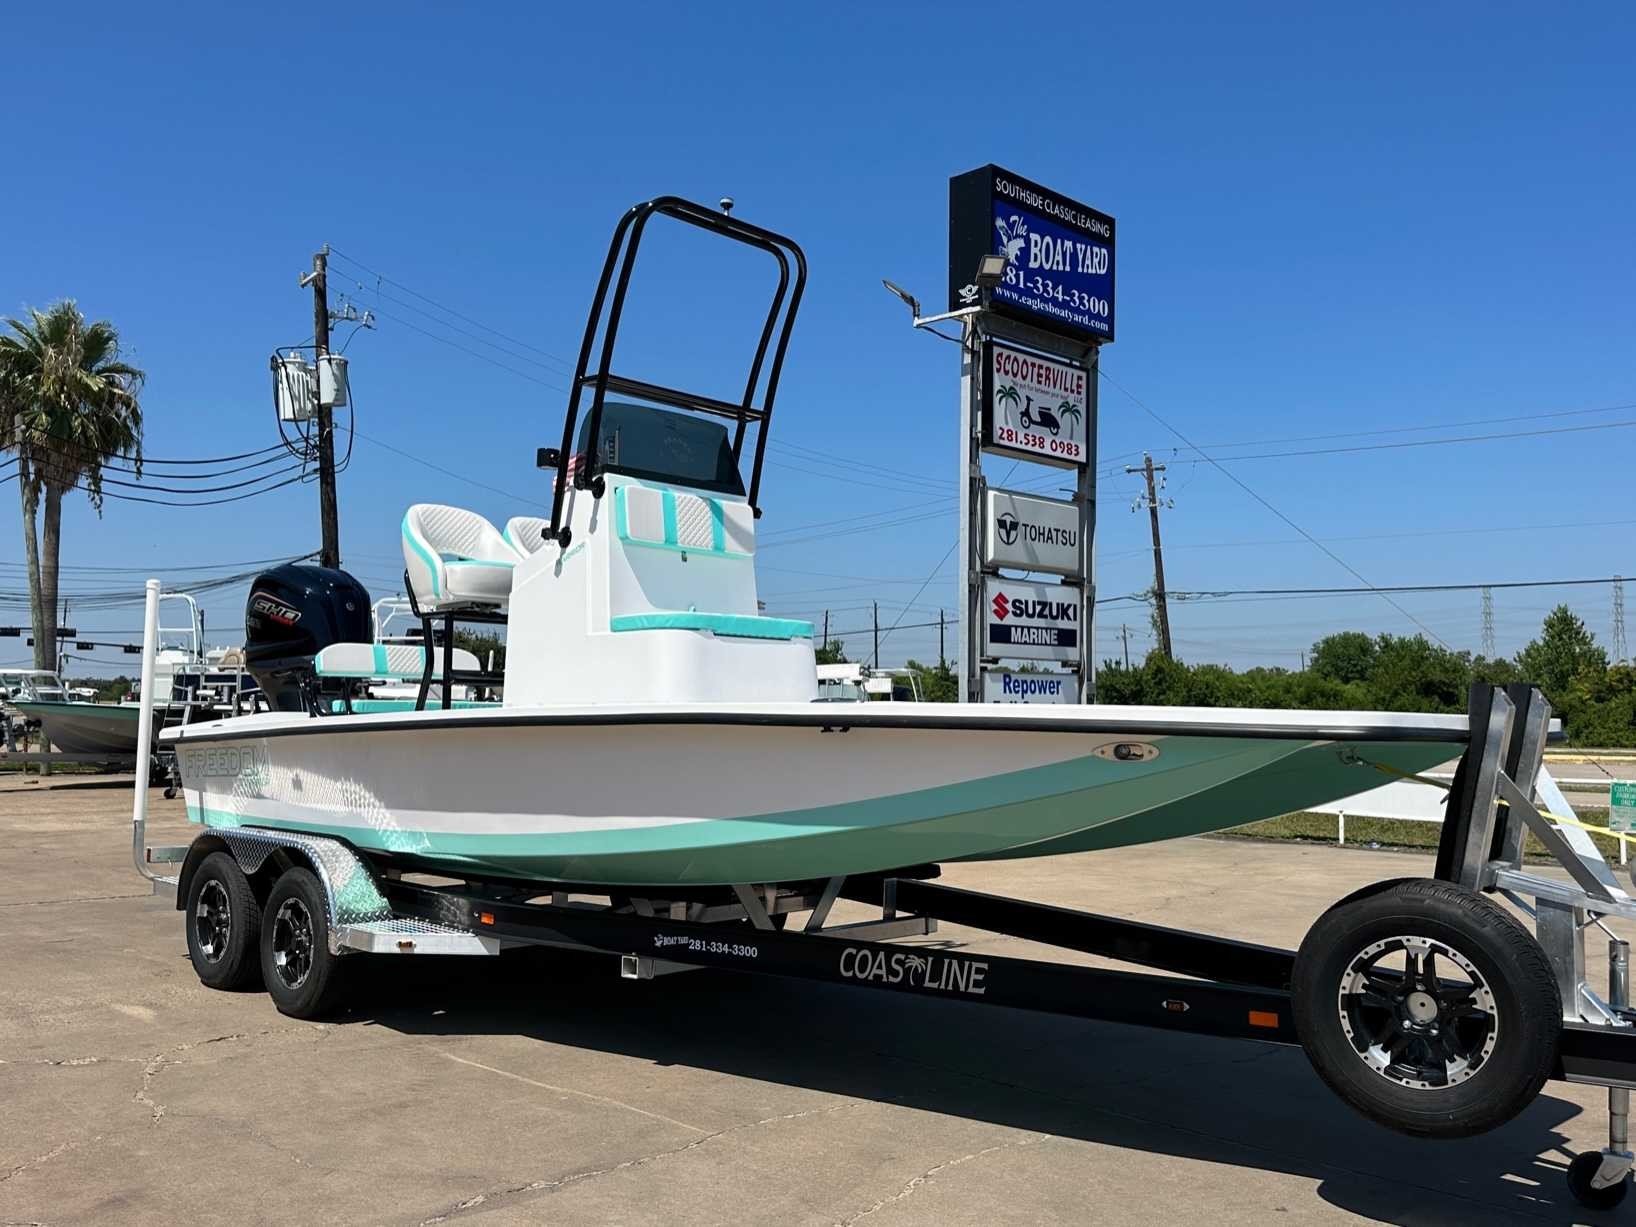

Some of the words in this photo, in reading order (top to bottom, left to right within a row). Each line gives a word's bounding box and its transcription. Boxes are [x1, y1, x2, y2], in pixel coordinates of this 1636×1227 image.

[995, 177, 1043, 210] SOUTHSIDE
[1044, 199, 1076, 224] CLASSIC
[1077, 212, 1110, 238] LEASING
[1010, 215, 1028, 237] The
[1028, 232, 1073, 272] BOAT
[1076, 242, 1109, 275] YARD
[994, 286, 1109, 332] www.eaglesboatyard.com
[995, 351, 1083, 396] SCOOTERVILLE
[998, 427, 1045, 449] 281.538
[1050, 439, 1080, 457] 0983
[1022, 523, 1077, 547] TOHATSU
[1011, 598, 1078, 622] SUZUKI
[1010, 626, 1059, 645] MARINE
[1002, 673, 1062, 700] Repower
[184, 742, 272, 778] FREEDOM
[688, 938, 758, 958] 281-334-3300
